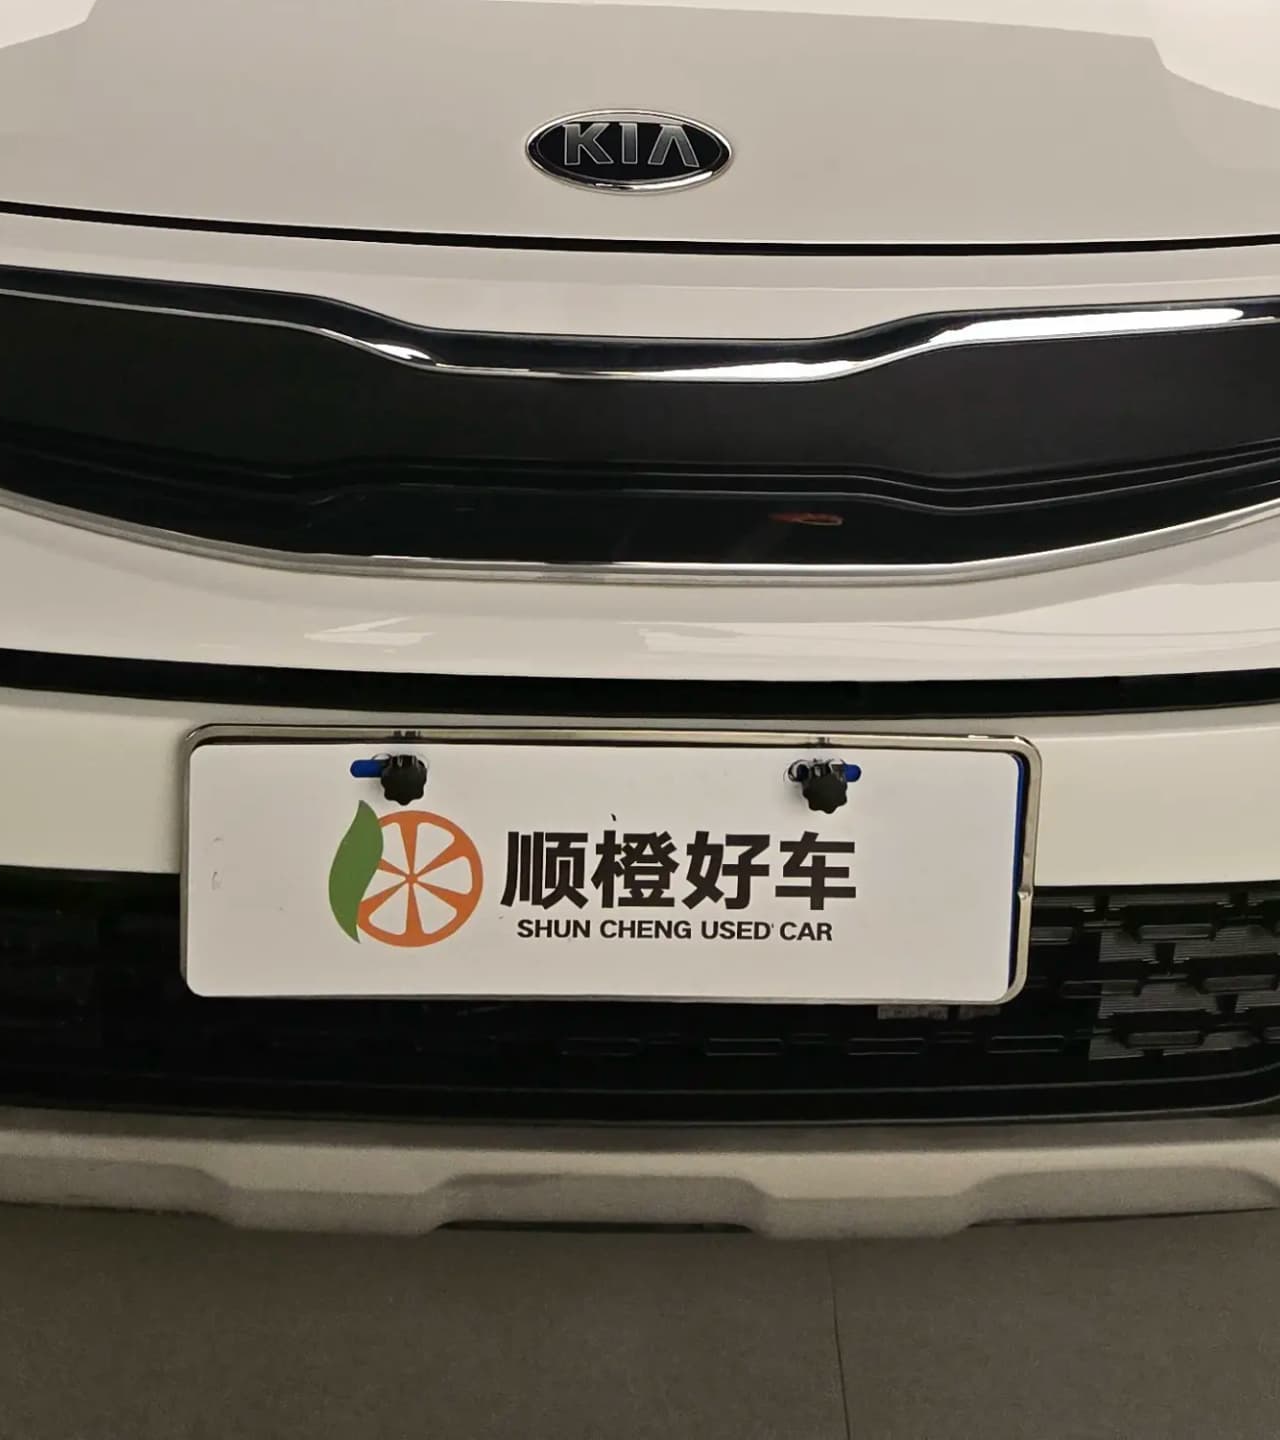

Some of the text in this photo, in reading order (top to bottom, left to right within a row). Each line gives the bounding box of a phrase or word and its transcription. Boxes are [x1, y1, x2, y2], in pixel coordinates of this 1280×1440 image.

[562, 122, 700, 168] KIA
[500, 829, 857, 911] 顺橙好车
[517, 919, 833, 942] SHUN CHENG USED CAR
